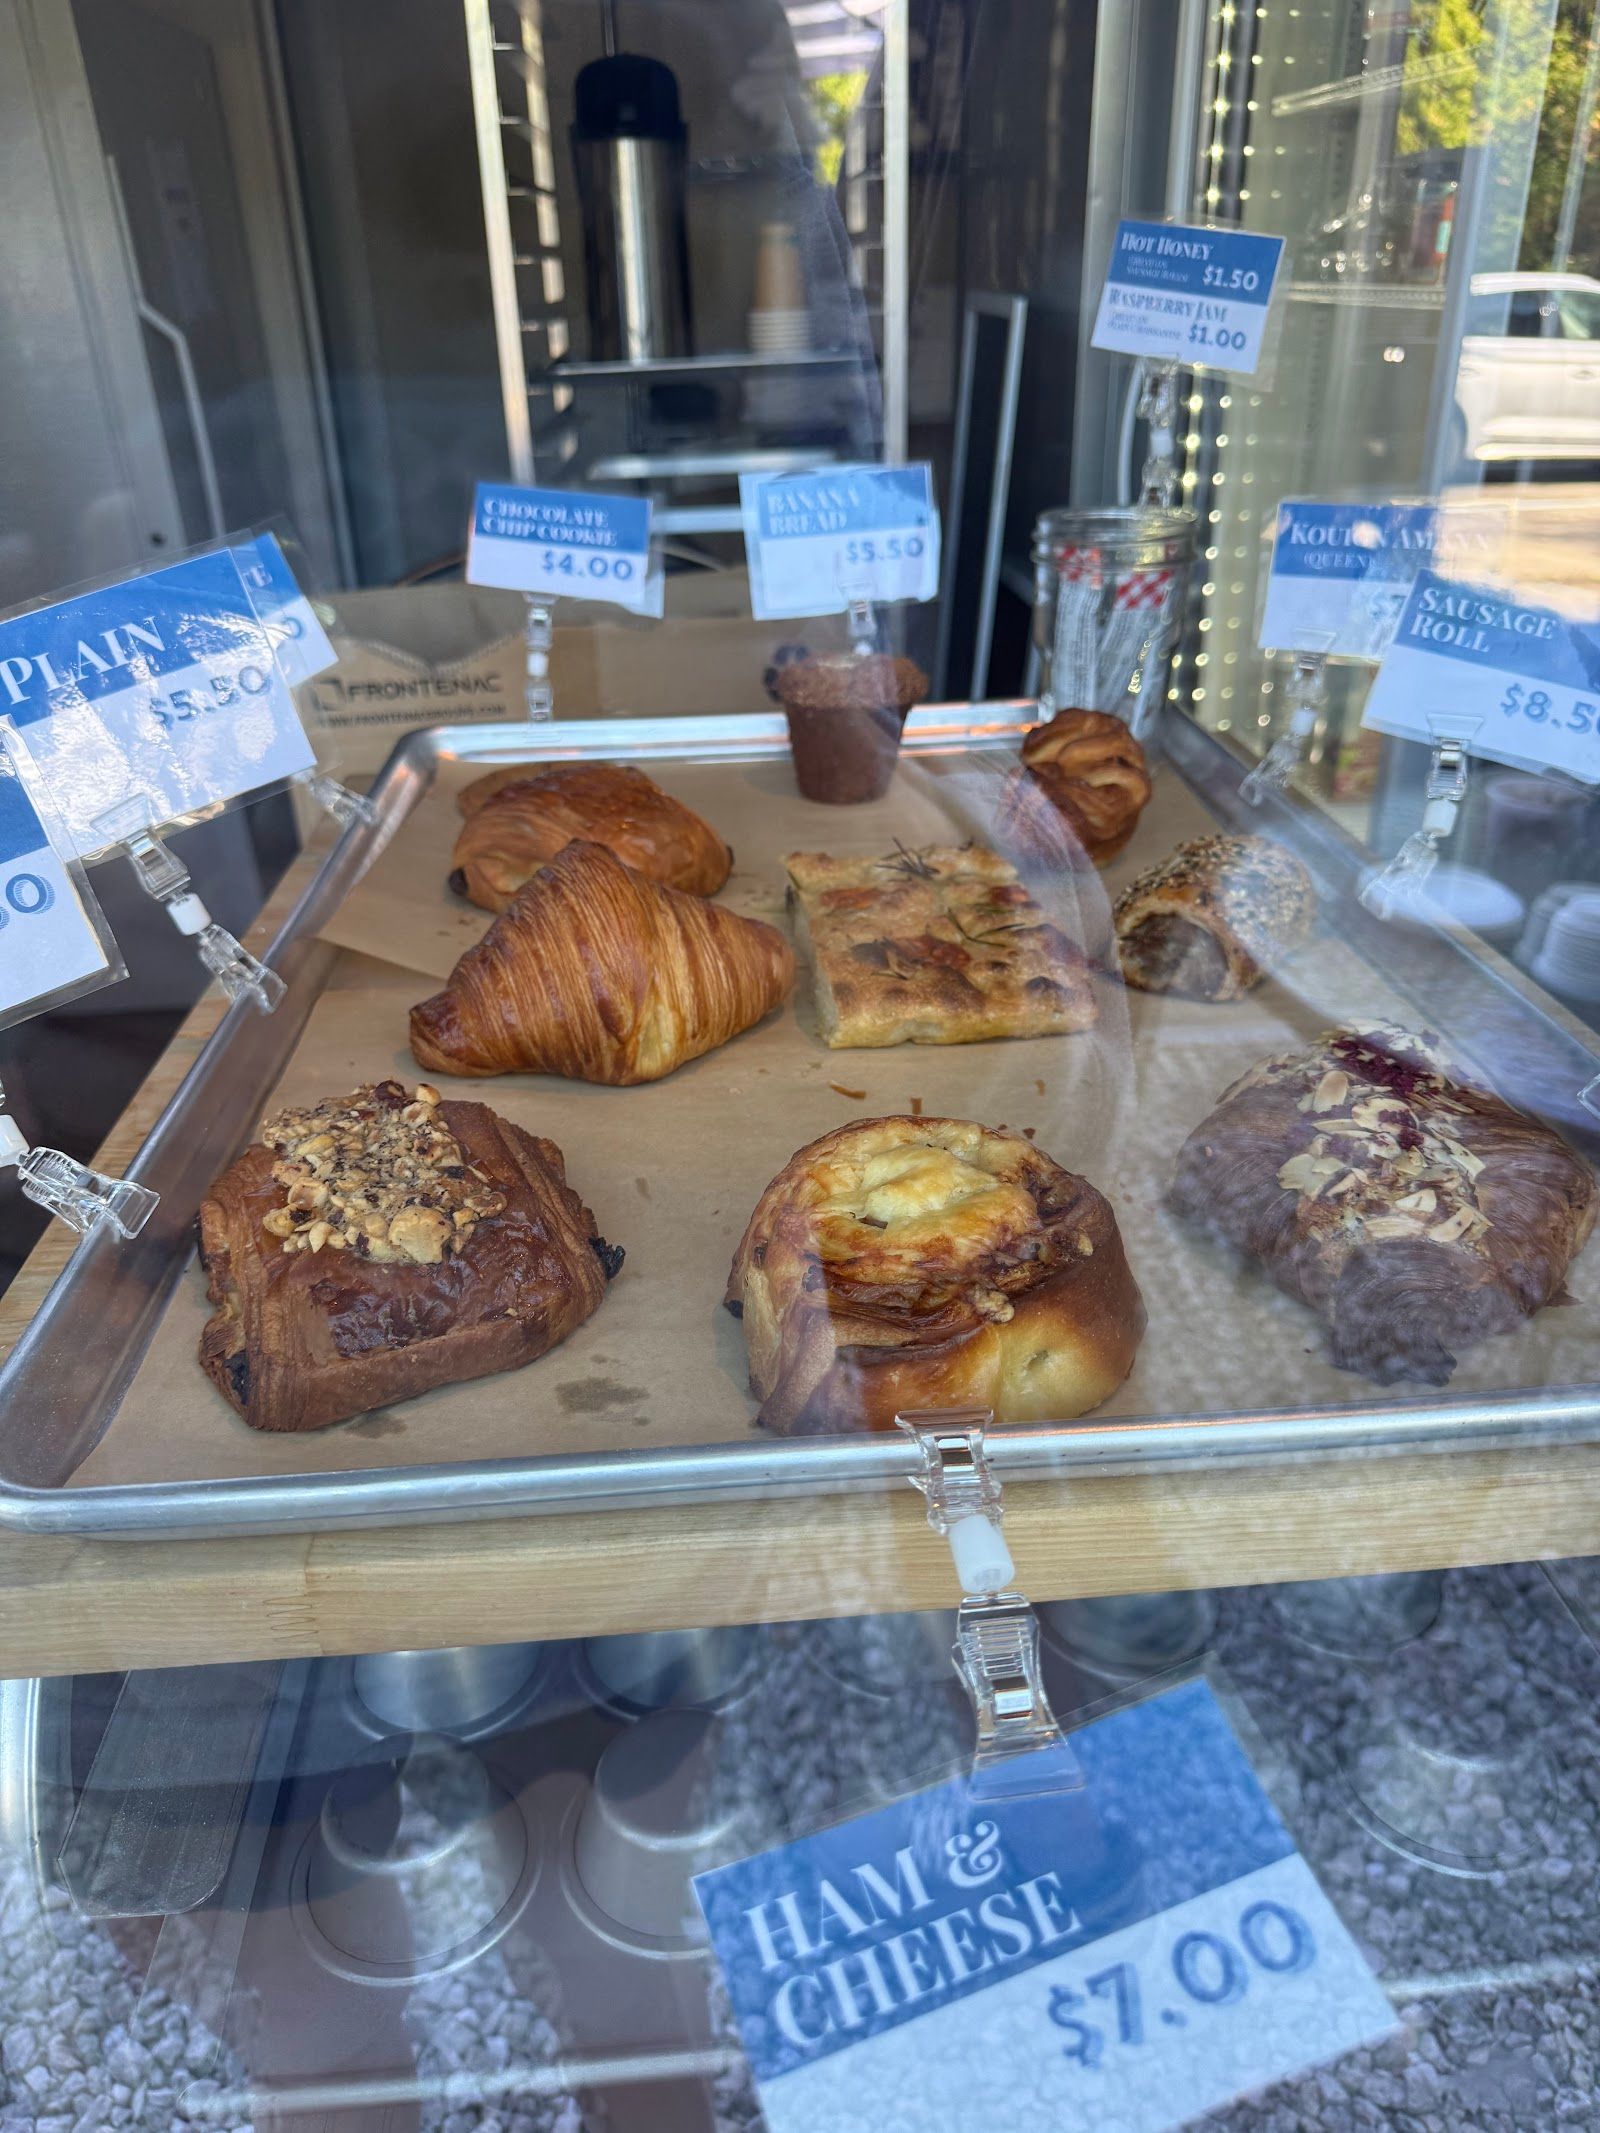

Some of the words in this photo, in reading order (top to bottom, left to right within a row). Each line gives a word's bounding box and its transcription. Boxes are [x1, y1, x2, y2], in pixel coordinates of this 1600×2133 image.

[1121, 232, 1154, 252] HOT
[1157, 237, 1214, 261] HONEY
[1202, 264, 1260, 291] $1.50
[1109, 288, 1197, 317] RASPBERRY
[1194, 301, 1228, 323] JAM
[1188, 324, 1247, 350] $1.00
[483, 497, 609, 528] CHOCOLATE
[481, 515, 535, 538] CHIP
[537, 524, 617, 547] COOKIE
[541, 549, 633, 580] $4.00
[847, 536, 924, 563] $5.50
[1418, 586, 1556, 640] SAUSAGE
[1410, 614, 1491, 653] ROLL
[0, 615, 166, 705] PLAIN
[150, 665, 273, 731] $5.50
[347, 672, 503, 702] FRONTENAC
[1500, 682, 1600, 737] $8.5
[741, 1846, 937, 1973] HAM
[943, 1819, 1004, 1889] &
[771, 1870, 1083, 2049] CHEESE
[1045, 1900, 1317, 2069] $7.00
